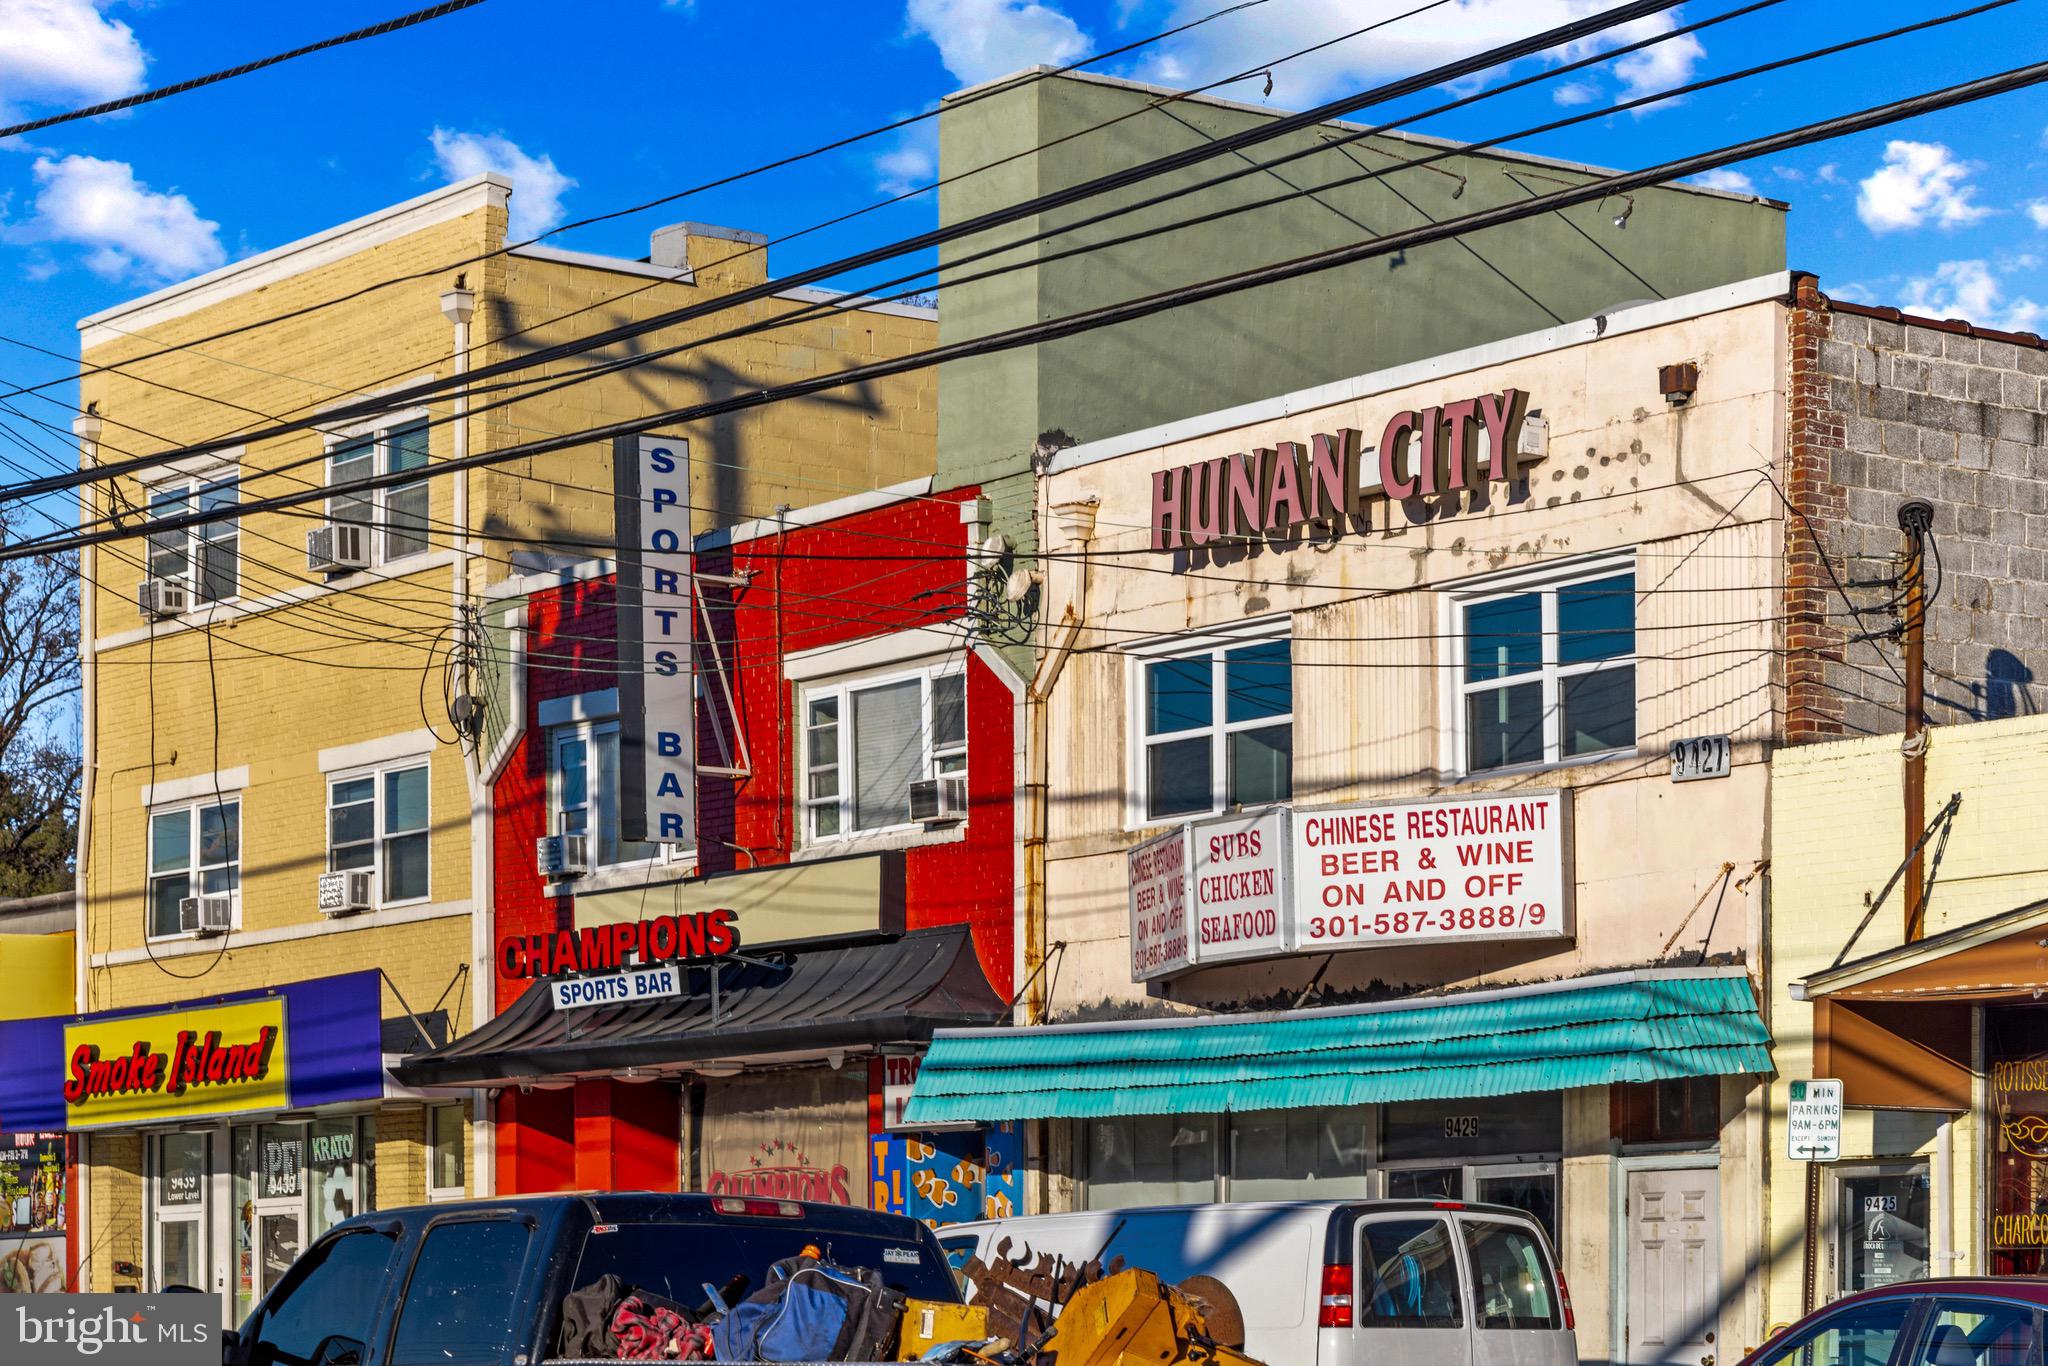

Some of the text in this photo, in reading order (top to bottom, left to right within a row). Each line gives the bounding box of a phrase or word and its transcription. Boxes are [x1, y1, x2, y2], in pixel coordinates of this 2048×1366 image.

[1150, 387, 1526, 551] HUNAN CITY
[650, 447, 684, 839] SPORTS BAR
[1675, 737, 1723, 776] 9427
[1306, 802, 1549, 847] CHINESE RESTAURANT
[1131, 839, 1184, 886] CHINESE RESTAURANT
[1210, 830, 1262, 863] SUBS
[1321, 840, 1534, 876] BEER & WINE
[1137, 876, 1184, 913] BEER & WINE
[1200, 868, 1274, 904] CHICKEN
[1322, 873, 1523, 907] ON AND OFF
[1138, 907, 1183, 941] ON AND OFF
[1201, 909, 1277, 944] SEAFOOD
[1309, 903, 1546, 938] 301-587-3888/9
[499, 909, 737, 979] CHAMPIONS
[560, 972, 673, 1005] SPORTS BAR
[64, 1025, 272, 1104] Smoke Island
[1792, 1105, 1838, 1115] PARKING
[1813, 1088, 1834, 1098] MIN
[1446, 1117, 1478, 1136] 9429
[1792, 1120, 1838, 1130] 9AM-6PM
[168, 1190, 199, 1201] Lower Level
[268, 1174, 297, 1195] 9439
[1866, 1196, 1896, 1211] 9425
